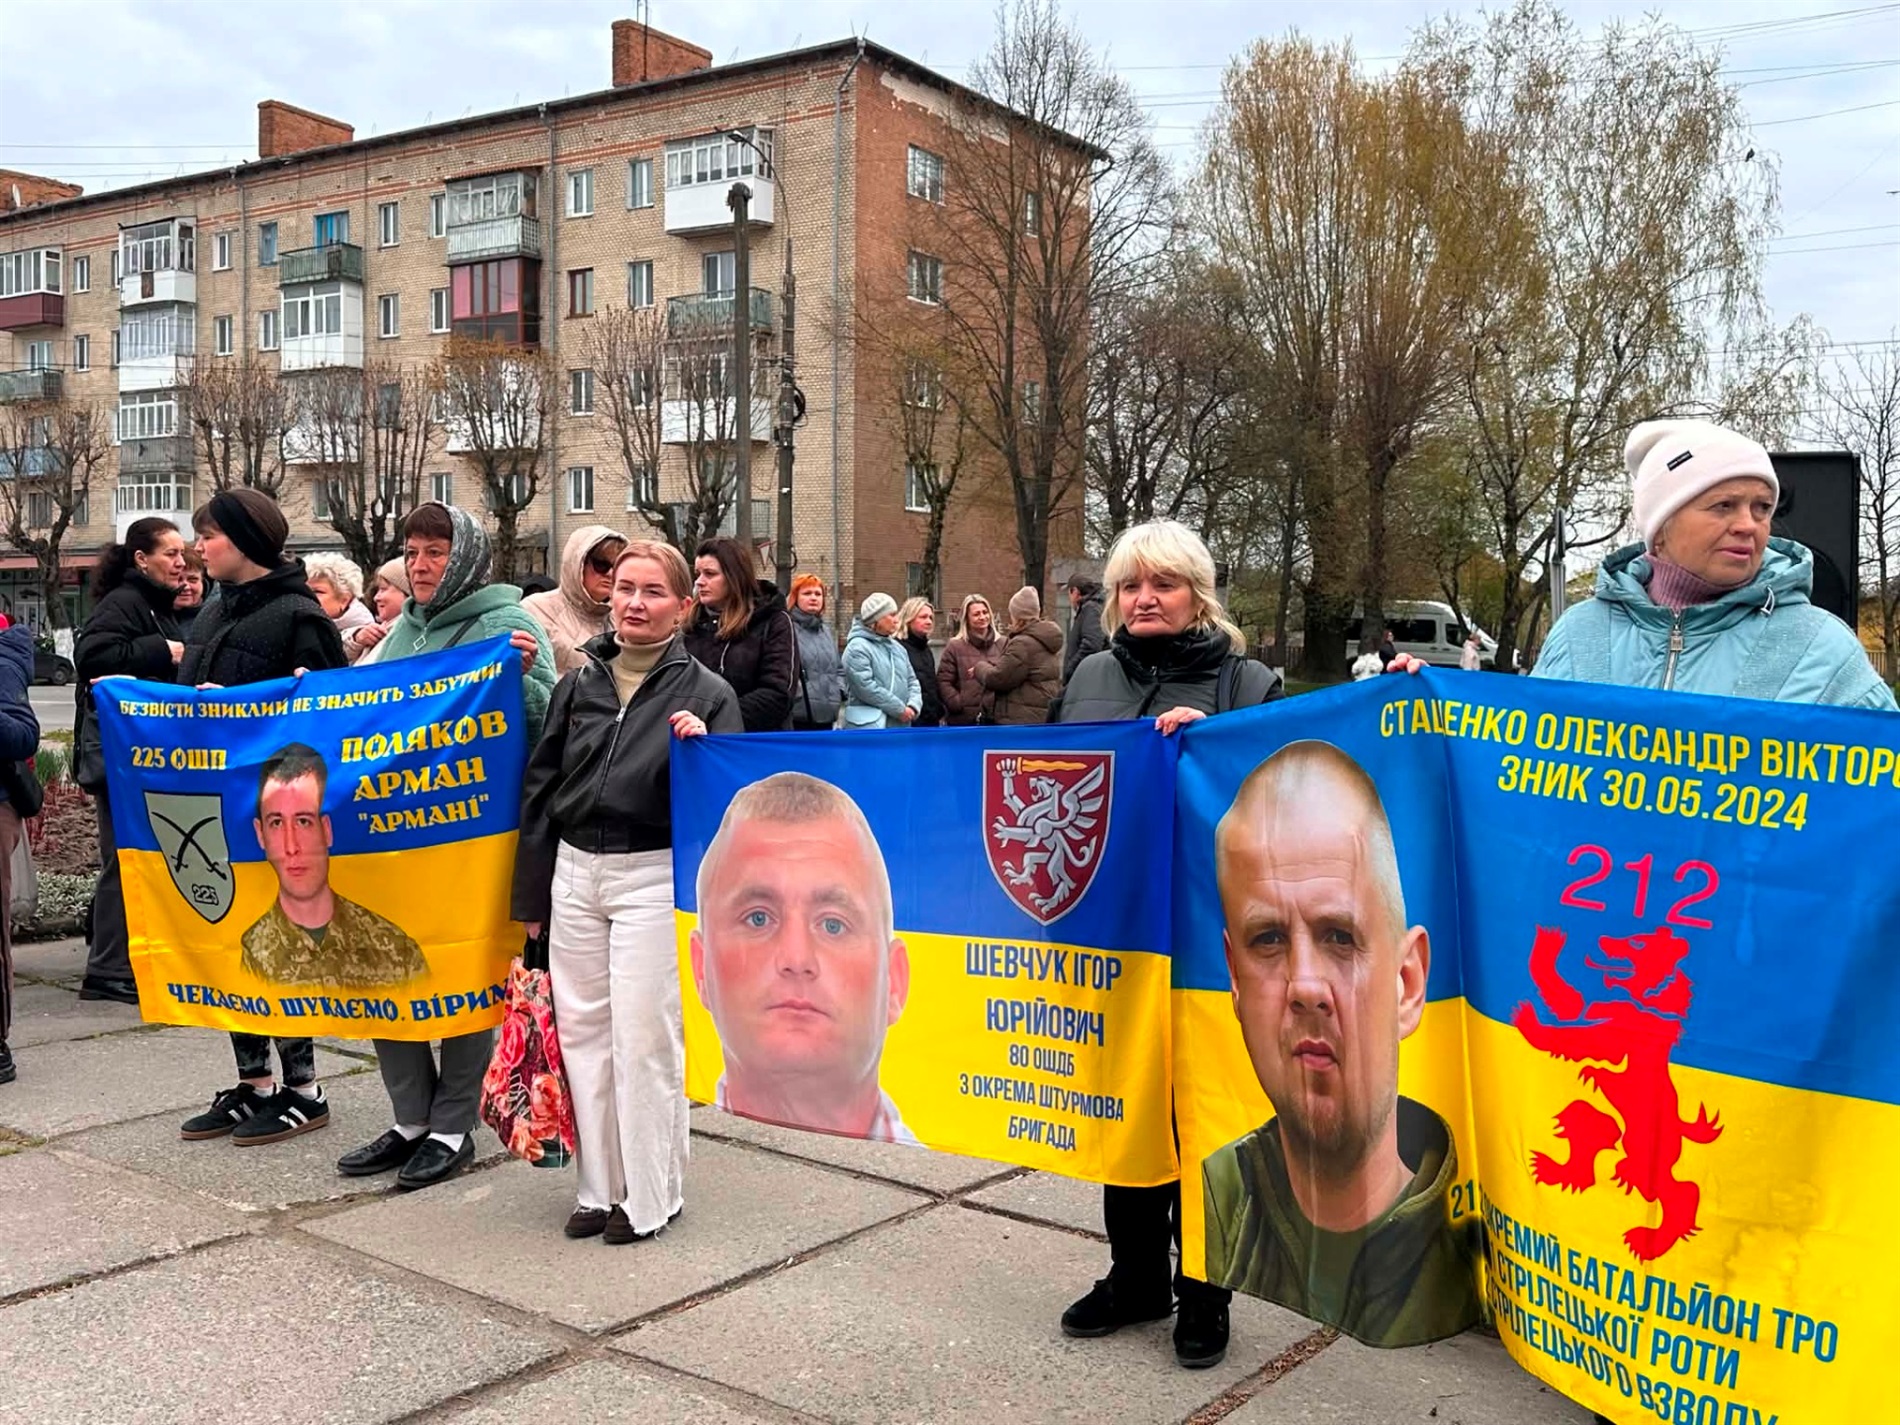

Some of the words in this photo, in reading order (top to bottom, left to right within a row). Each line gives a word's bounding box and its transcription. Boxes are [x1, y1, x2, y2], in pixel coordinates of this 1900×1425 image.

[120, 700, 193, 718] БЕЗВІСТИ
[198, 698, 289, 719] ЗНИКЛИЙ
[292, 695, 314, 713] НЕ
[316, 687, 404, 712] ЗНАЧИТЬ
[131, 746, 166, 769] 225
[170, 747, 227, 771] ОШП
[340, 710, 508, 764] ПОЛЯКОВ
[1535, 713, 1750, 775] ОЛЕКСАНДР
[354, 757, 487, 802] АРМАН
[1498, 755, 1593, 804] ЗНИК
[1600, 769, 1809, 832] 30.05.2024
[358, 794, 490, 835] "АРМАНІ"
[192, 883, 219, 906] 225
[1559, 844, 1720, 929] 212
[966, 943, 1067, 985] ШЕВЧУК
[1074, 952, 1122, 991] ІГОР
[987, 997, 1105, 1047] ЮРІЙОВИЧ
[1009, 1044, 1030, 1068] 80
[1033, 1046, 1075, 1077] ОШДБ
[972, 1075, 1036, 1107] ОКРЕМА
[1039, 1084, 1124, 1122] ШТУРМОВА
[1008, 1116, 1076, 1152] БРИГАДА
[1497, 1249, 1645, 1360] СТРІЛЕЦЬКОЇ
[1650, 1327, 1740, 1390] РОТИ
[1568, 1248, 1760, 1343] БАТАЛЬЙОН
[1772, 1307, 1838, 1363] ТРО
[1491, 1276, 1633, 1397] СТРІЛЕЦЬКОГО
